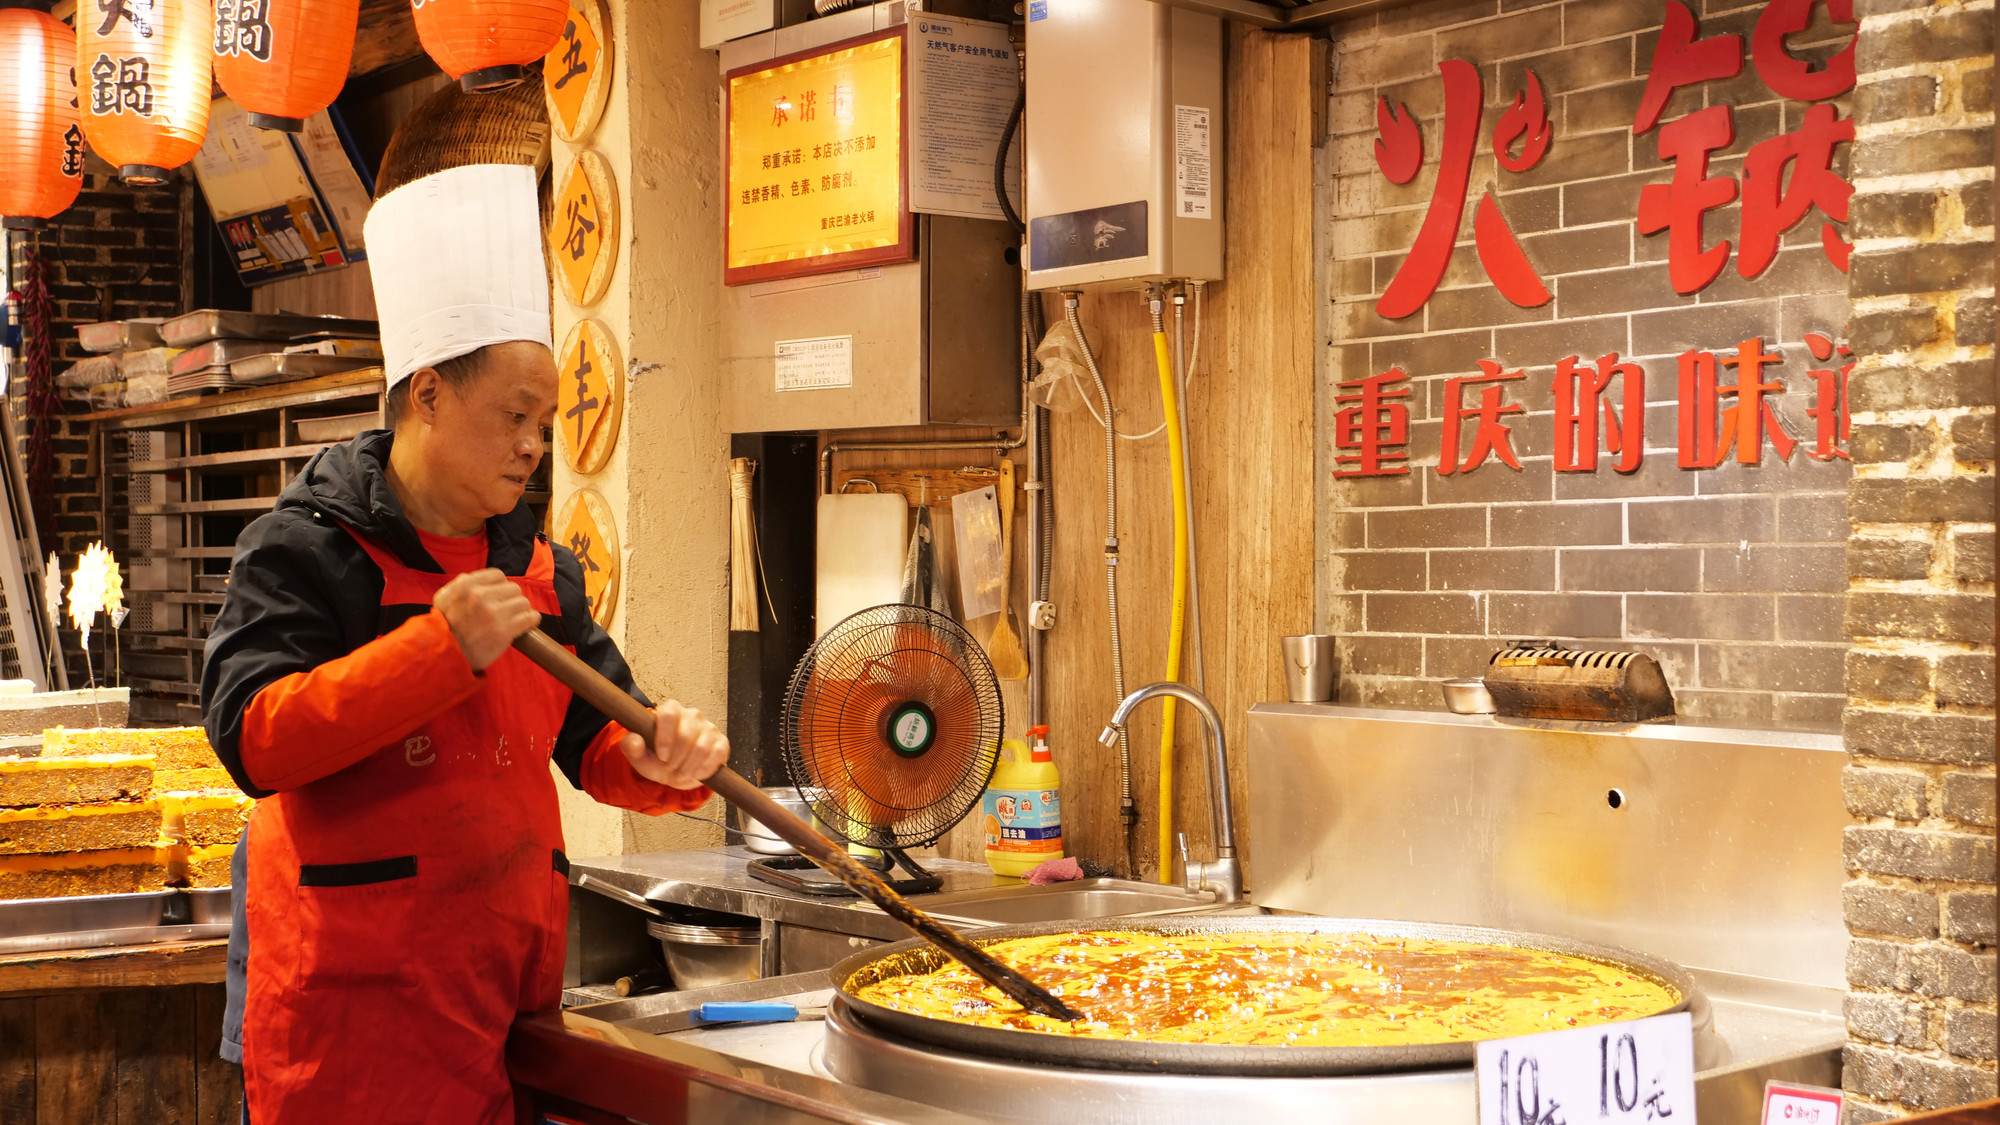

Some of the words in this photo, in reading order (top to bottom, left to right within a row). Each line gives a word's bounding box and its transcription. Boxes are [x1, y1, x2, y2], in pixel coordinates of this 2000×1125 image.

[554, 19, 588, 90] 五
[926, 40, 1009, 60] 天然气客户安全用气须知
[1374, 0, 1857, 319] 火锅
[561, 194, 595, 262] 谷
[820, 210, 875, 230] 重庆巴渝老火锅
[566, 339, 599, 449] 丰
[1600, 1032, 1673, 1121] 10元
